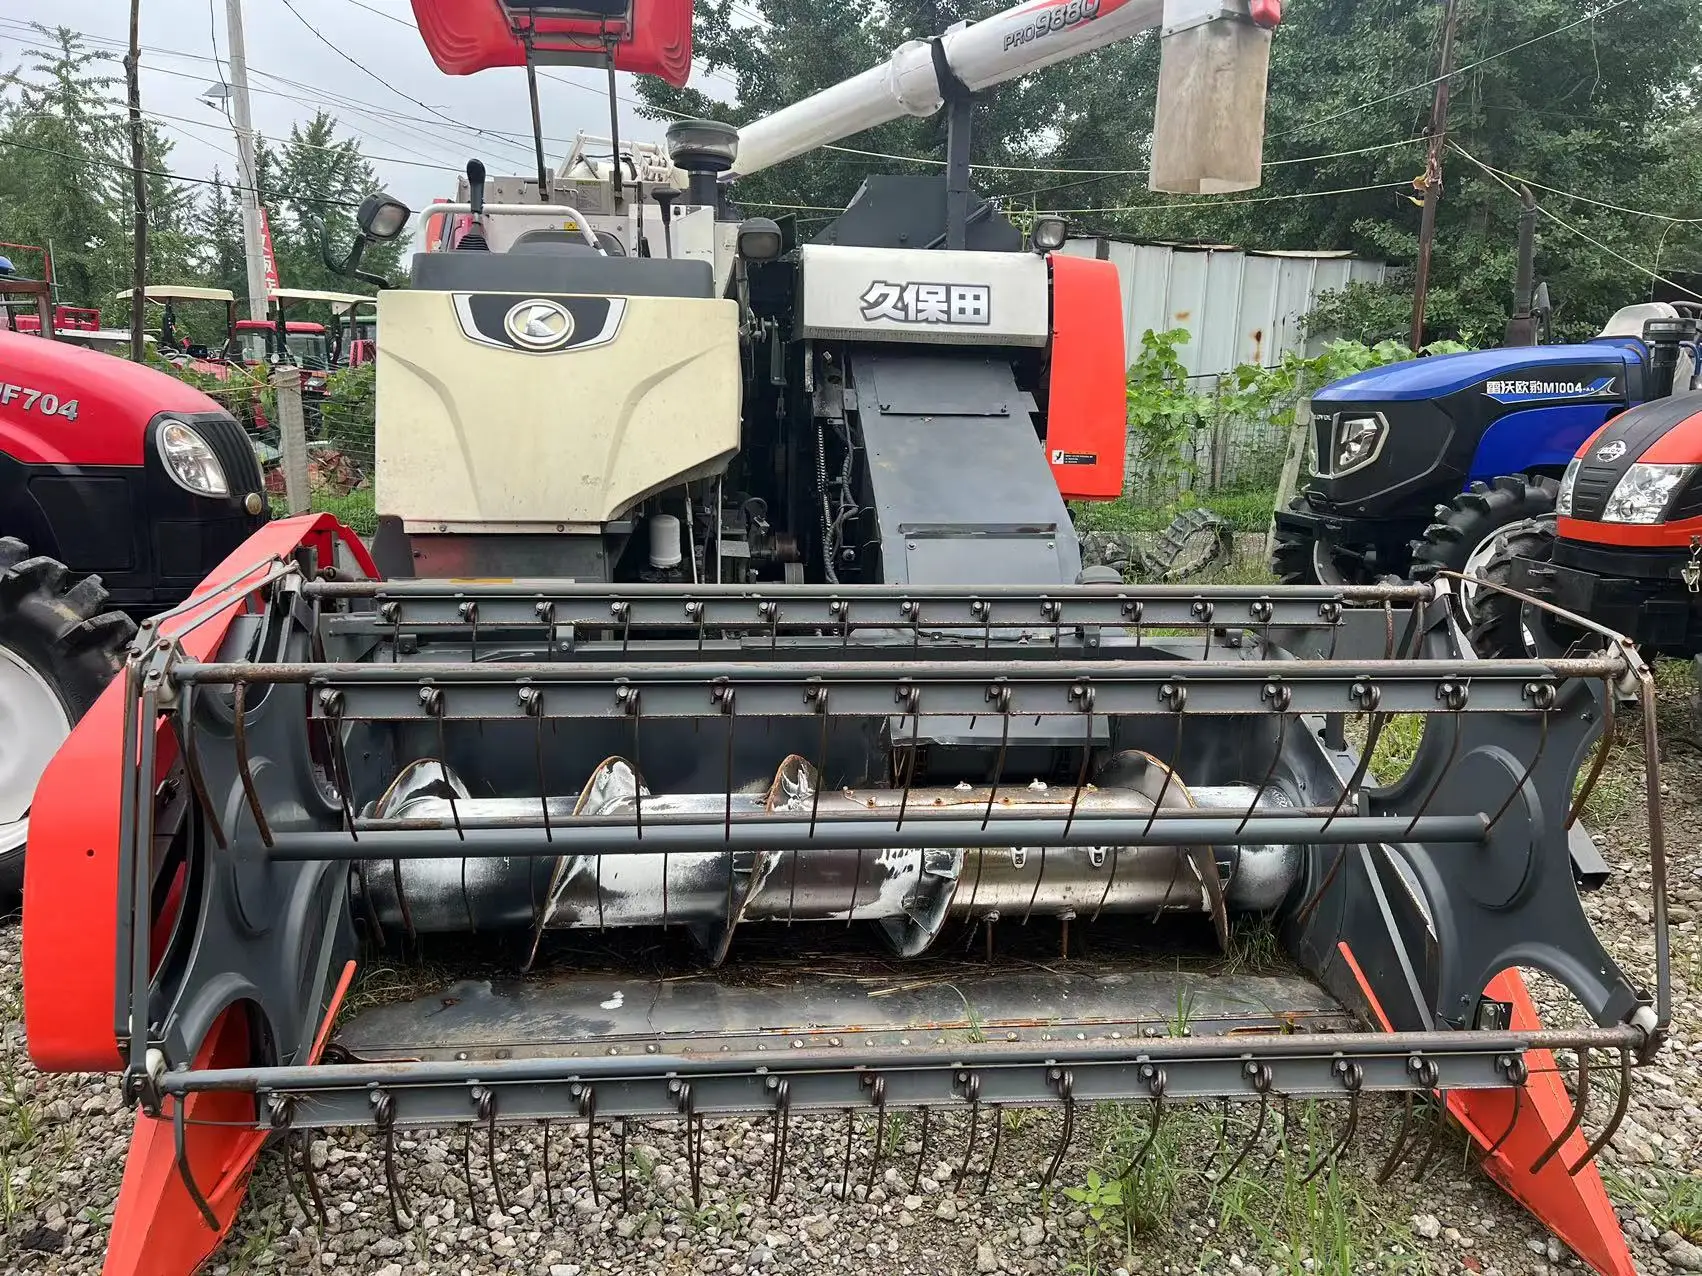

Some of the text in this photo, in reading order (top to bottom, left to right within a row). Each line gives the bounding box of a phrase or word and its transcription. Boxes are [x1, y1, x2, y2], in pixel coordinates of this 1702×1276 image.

[860, 280, 990, 325] 久保田
[0, 382, 79, 421] F704
